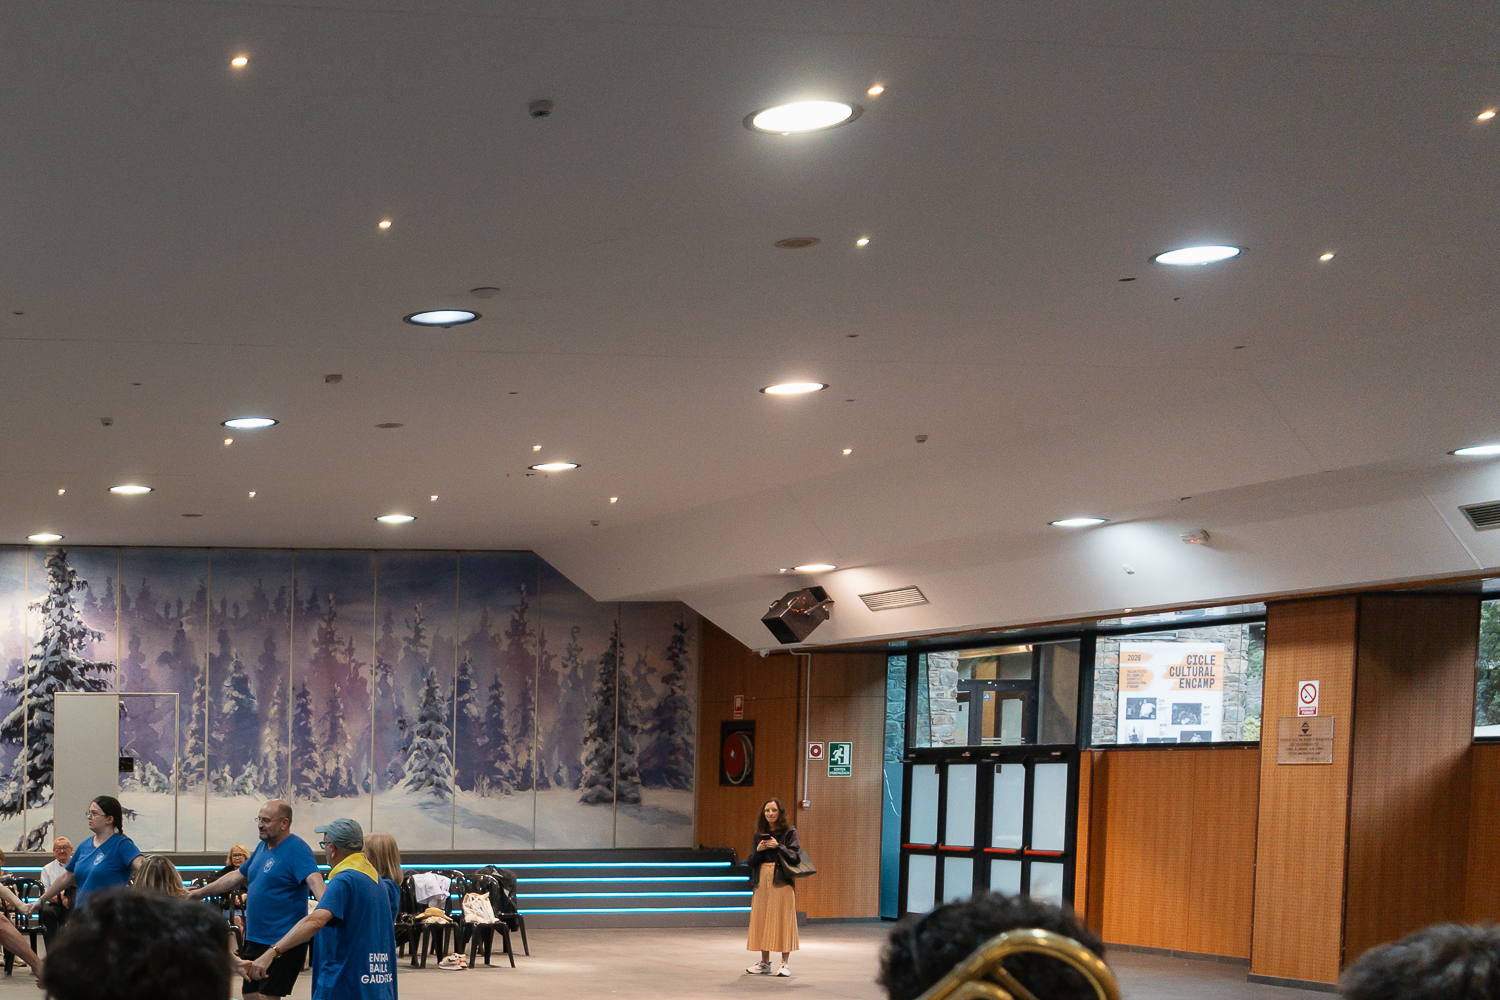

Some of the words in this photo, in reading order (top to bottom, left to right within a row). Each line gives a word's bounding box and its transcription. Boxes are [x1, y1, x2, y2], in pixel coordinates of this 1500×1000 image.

[1186, 654, 1216, 666] CICLE
[1169, 666, 1216, 677] CULTURAL
[1179, 678, 1215, 688] ENCAMP
